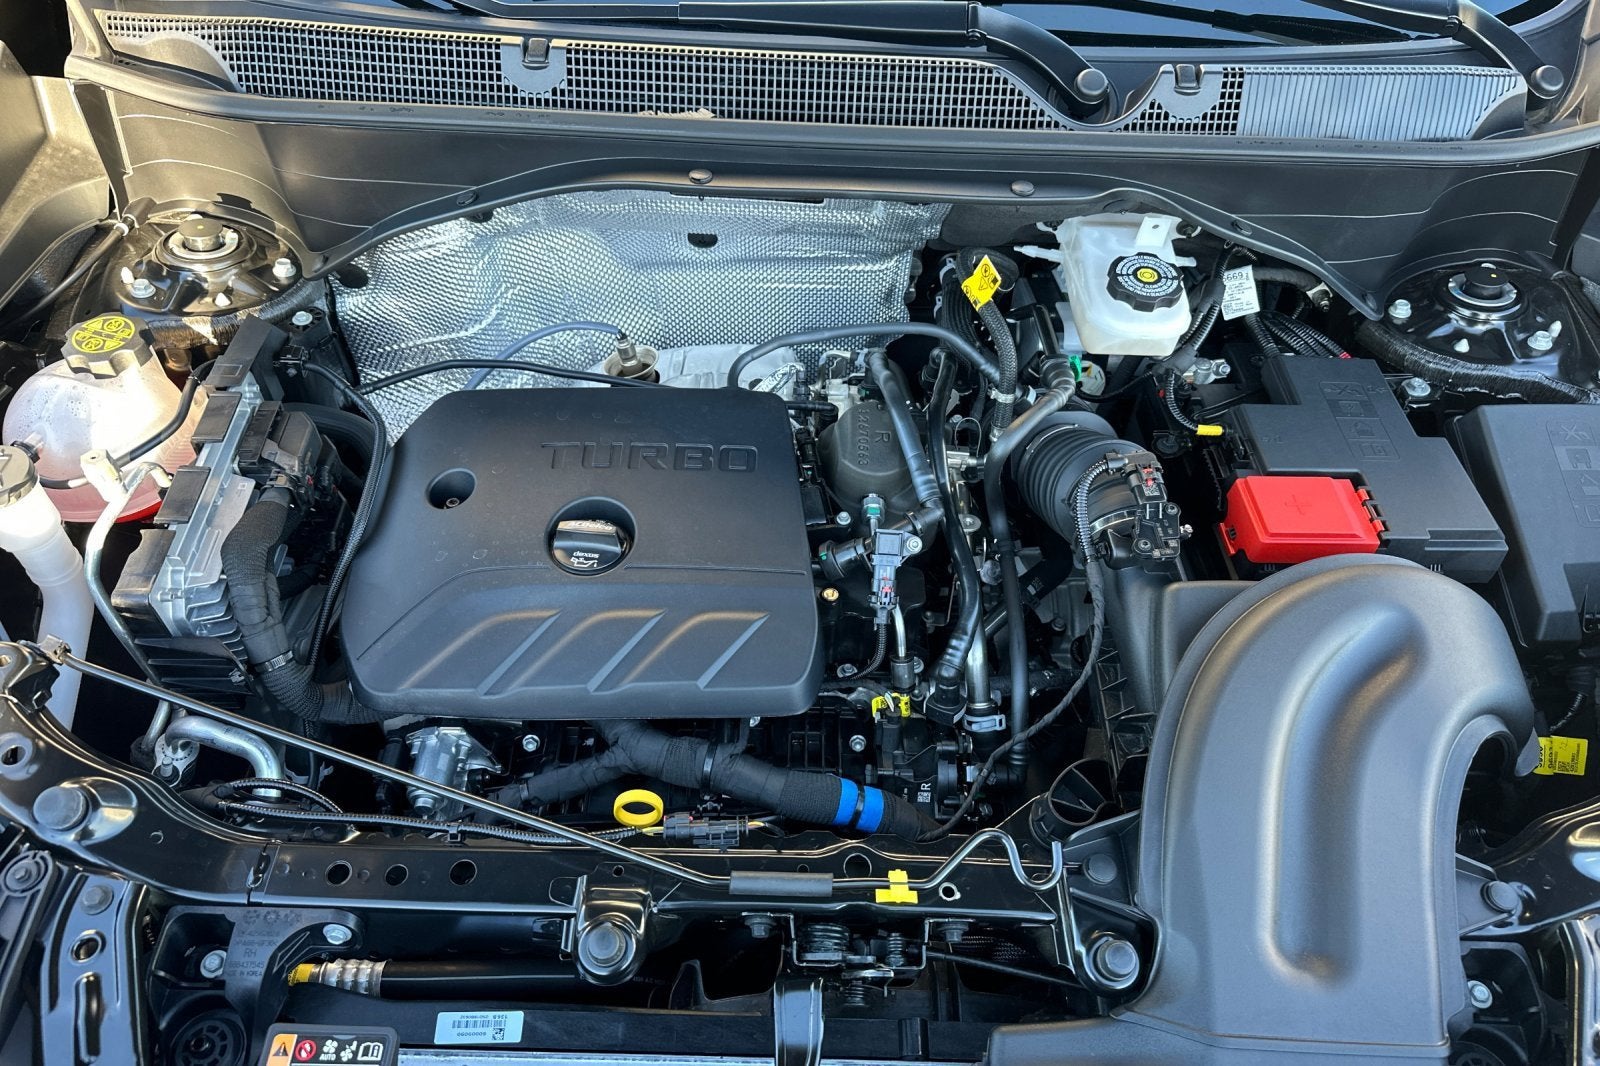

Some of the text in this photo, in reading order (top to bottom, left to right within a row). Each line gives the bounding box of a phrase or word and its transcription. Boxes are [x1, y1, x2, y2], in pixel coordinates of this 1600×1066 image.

[875, 430, 891, 443] R
[541, 441, 758, 472] TURBO
[920, 782, 931, 791] R
[243, 947, 257, 958] RH
[319, 1053, 336, 1061] AUTO
